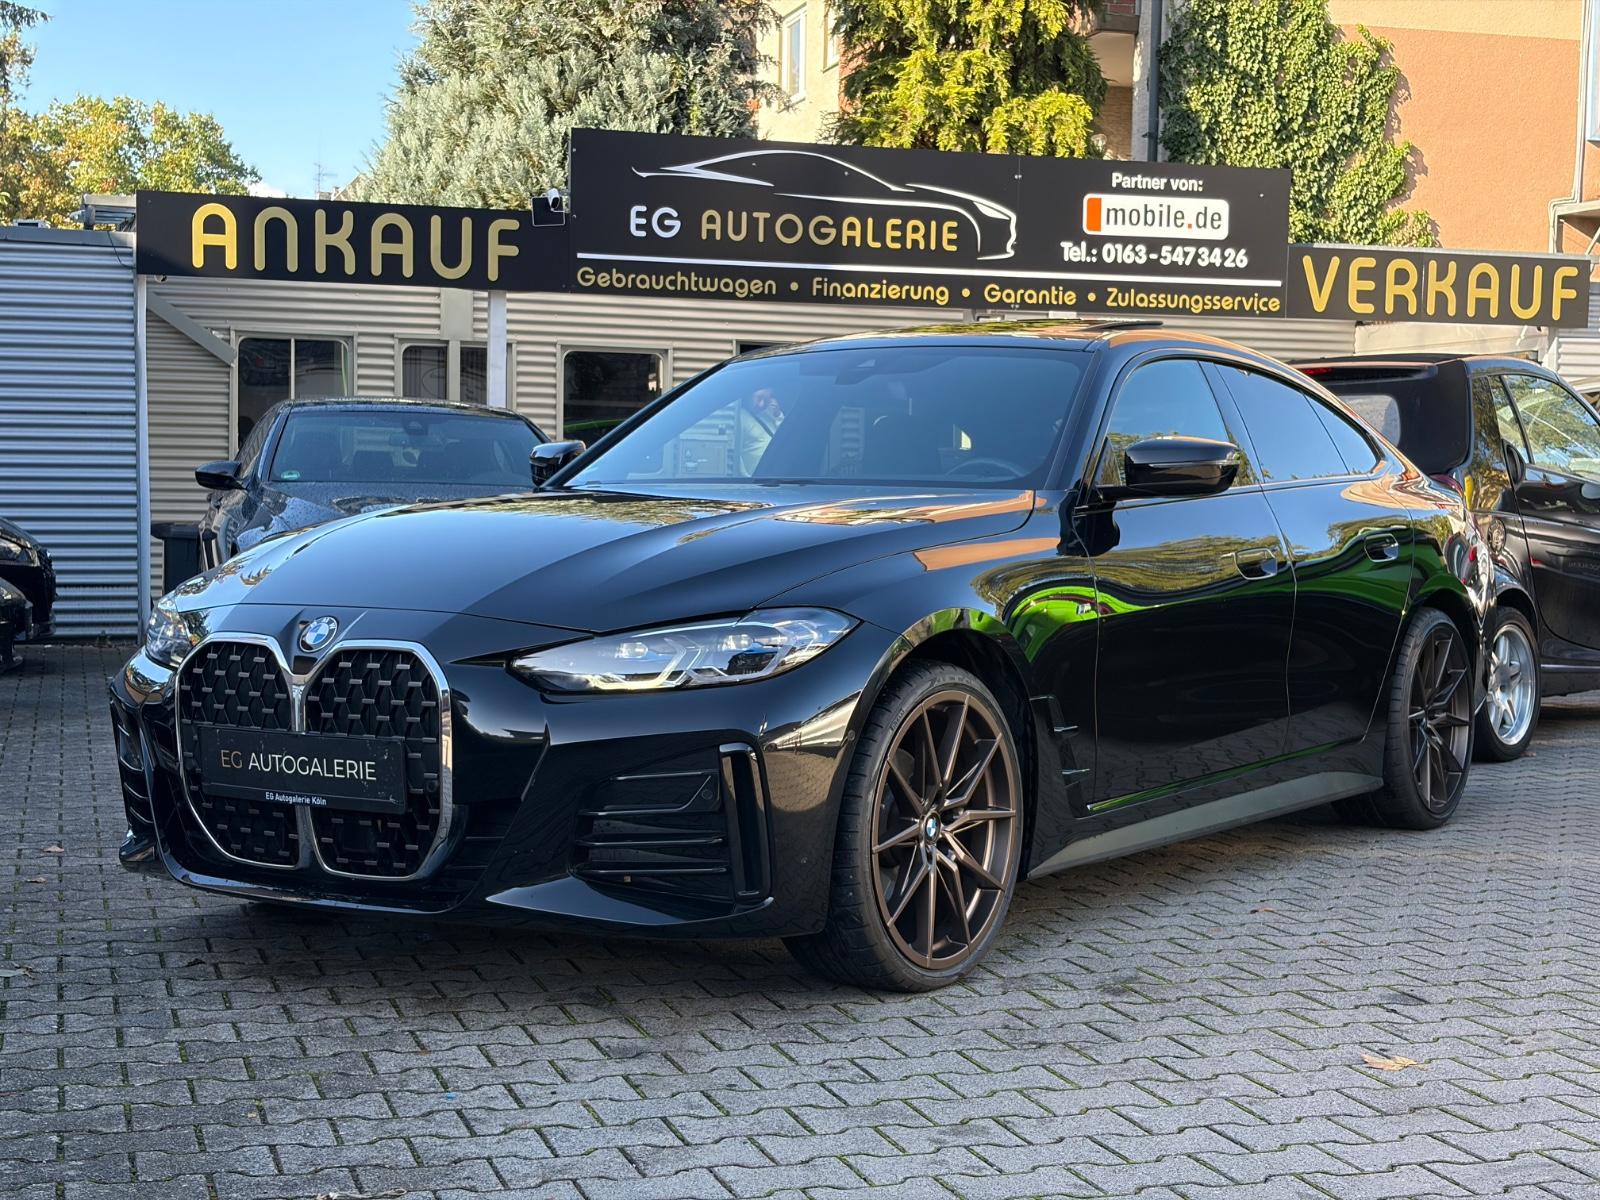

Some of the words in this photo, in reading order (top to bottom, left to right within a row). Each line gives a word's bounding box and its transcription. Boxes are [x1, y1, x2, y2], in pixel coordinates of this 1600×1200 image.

[1111, 172, 1167, 191] Partner
[1169, 178, 1204, 192] von:
[629, 204, 682, 239] EG
[700, 208, 959, 252] AUTOGALERIE
[1106, 203, 1222, 230] mobile.de
[191, 202, 521, 282] ANKAUF
[1060, 241, 1098, 264] Tel.:
[576, 266, 777, 298] Gebrauchtwagen
[811, 276, 949, 306] Finanzierung
[984, 283, 1077, 306] Garantie
[1106, 287, 1281, 314] Zulassungsservice
[1302, 254, 1580, 321] VERKAUF
[220, 749, 243, 769] EG
[248, 752, 377, 781] AUTOGALERIE
[265, 791, 274, 800] EG
[275, 793, 310, 804] Autogalerie
[311, 796, 327, 806] Köln
